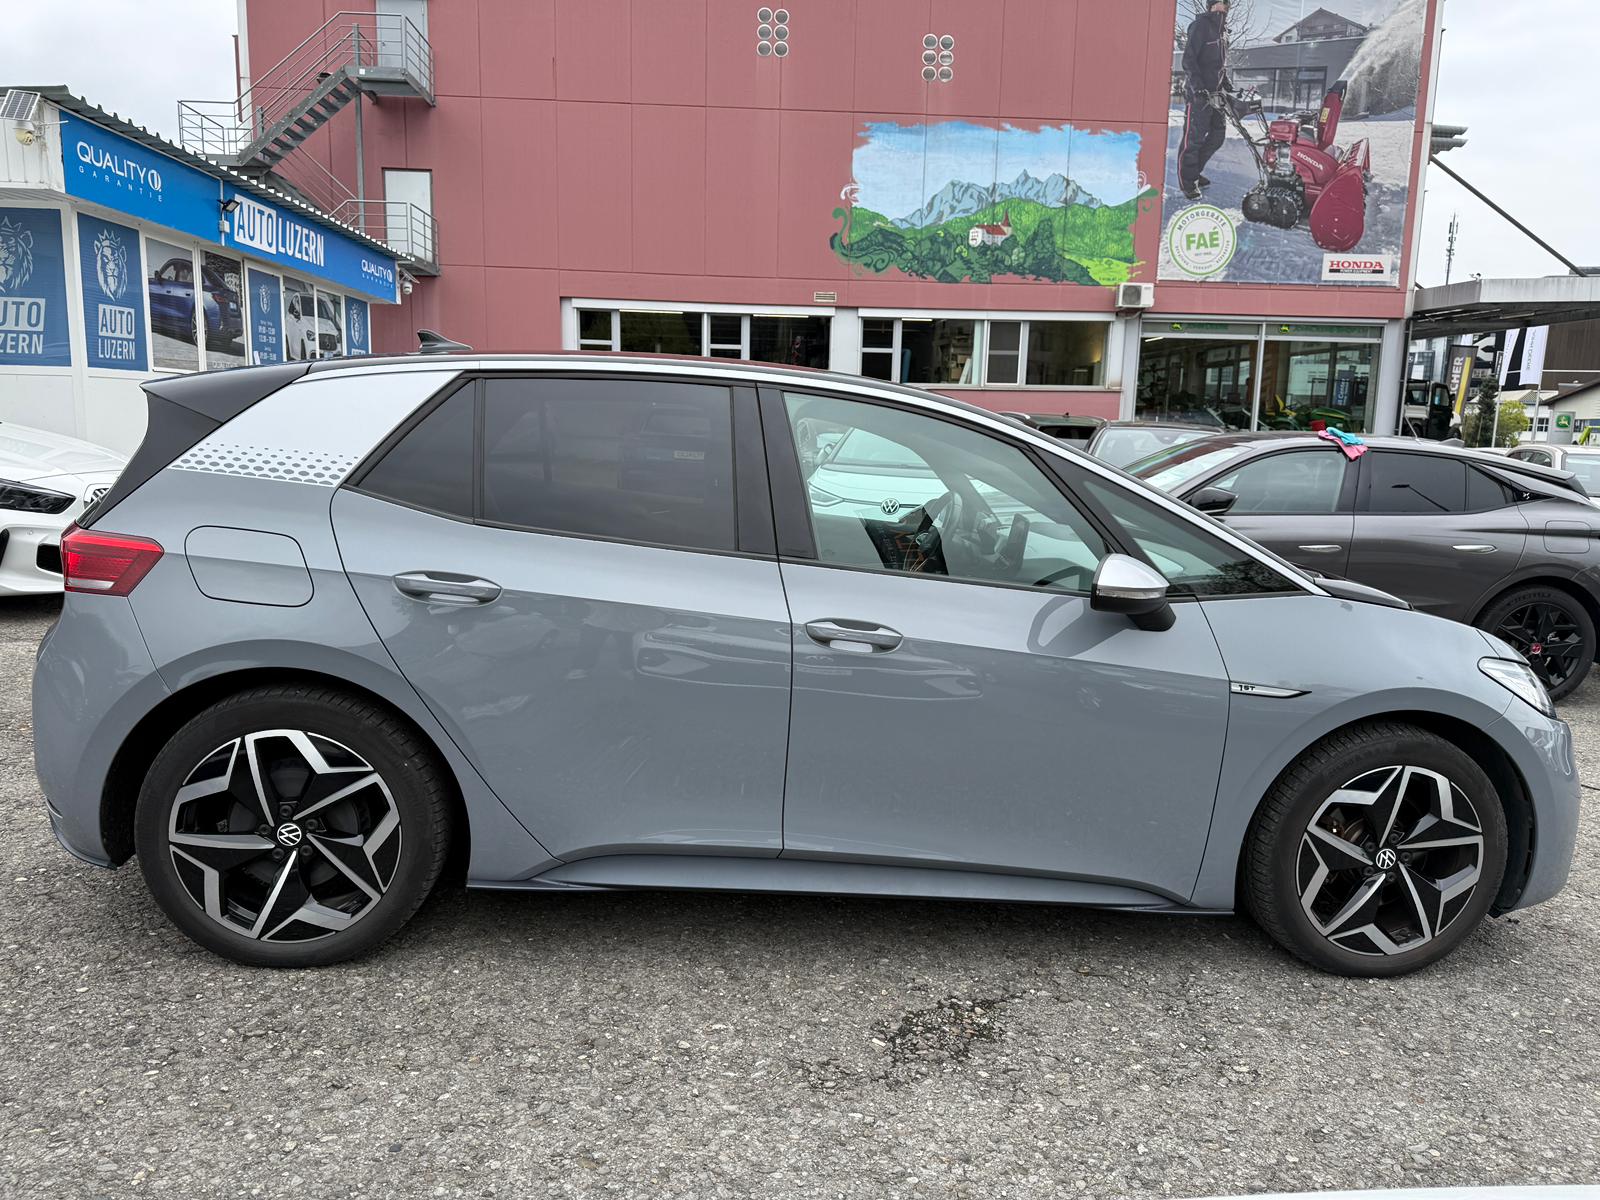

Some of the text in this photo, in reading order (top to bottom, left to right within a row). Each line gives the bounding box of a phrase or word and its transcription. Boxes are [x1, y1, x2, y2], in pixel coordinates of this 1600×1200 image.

[77, 140, 146, 184] QUALITY
[1297, 151, 1324, 171] HONDA
[79, 165, 162, 202] GARANTIE
[235, 200, 325, 267] AUTO LUZERN
[1185, 226, 1220, 250] FAÉ
[361, 259, 387, 280] QUALITY
[1329, 260, 1384, 269] HONDA
[0, 300, 42, 328] UTO
[100, 308, 134, 336] AUTO
[0, 332, 44, 354] ZERN
[98, 338, 136, 360] LUZERN
